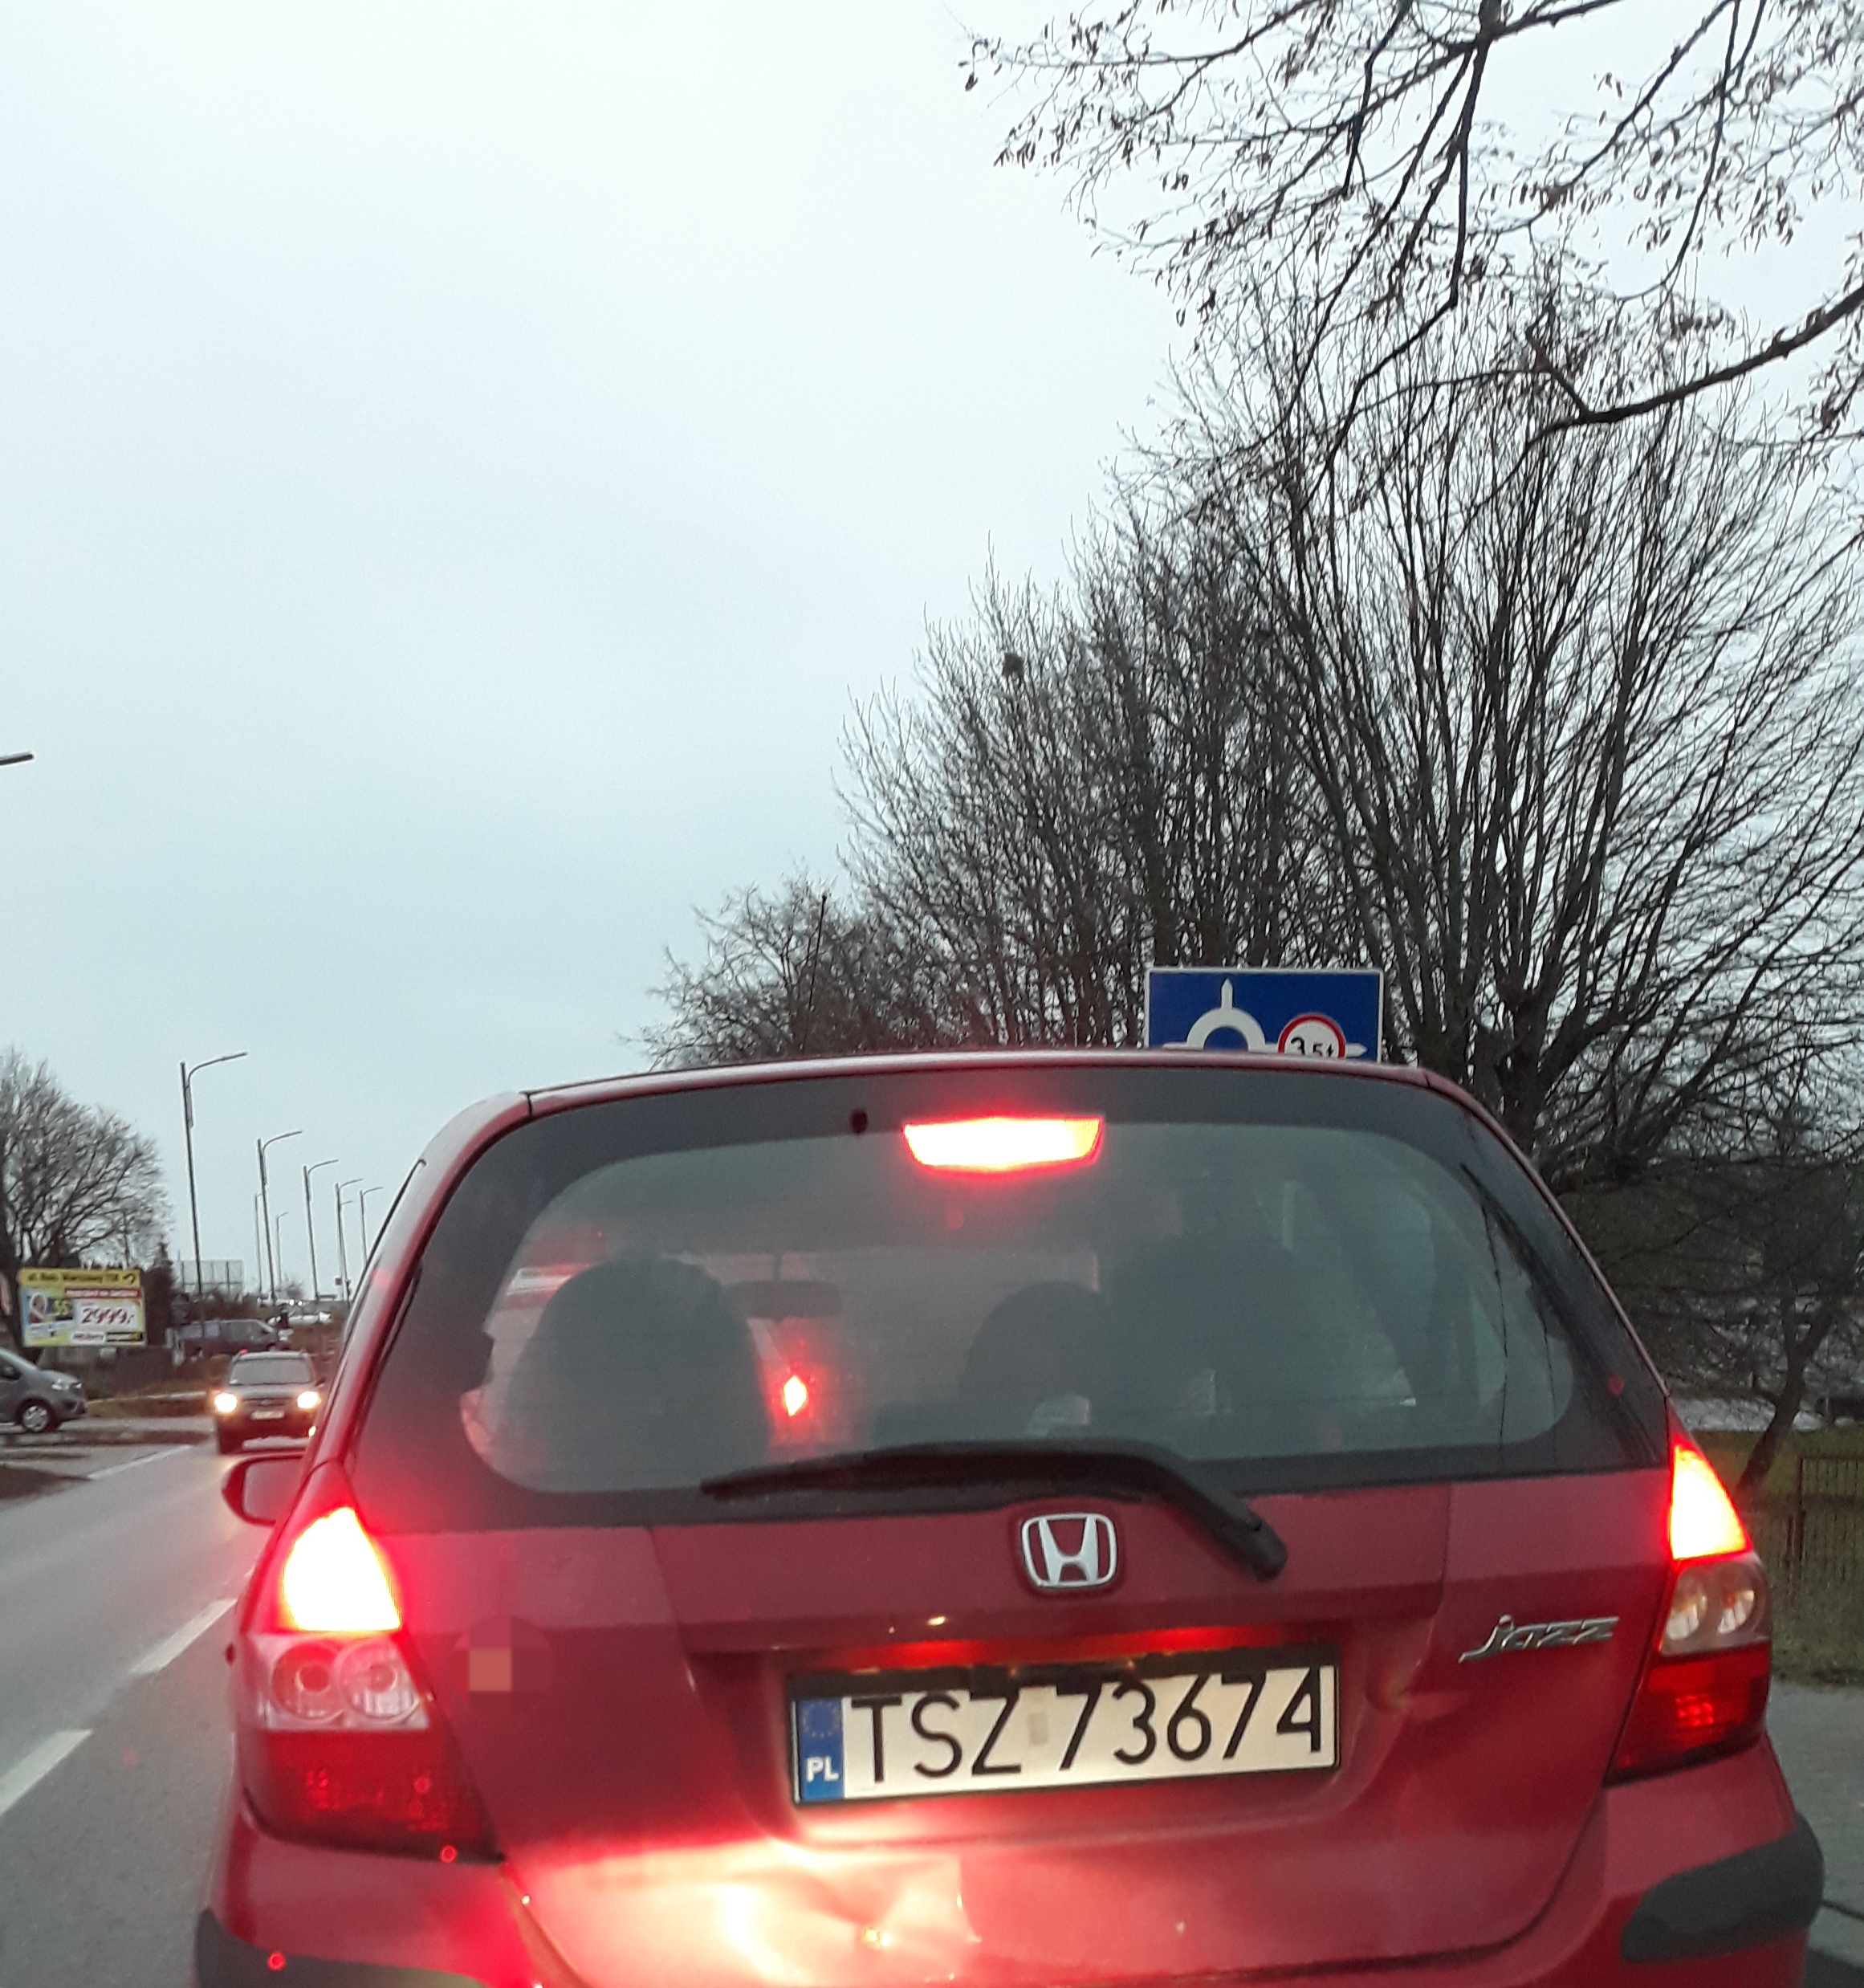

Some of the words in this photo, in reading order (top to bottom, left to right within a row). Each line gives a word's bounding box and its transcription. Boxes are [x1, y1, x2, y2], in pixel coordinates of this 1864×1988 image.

[851, 1685, 1022, 1782] TSZ
[1055, 1665, 1323, 1771] 73674
[805, 1758, 840, 1782] PL
